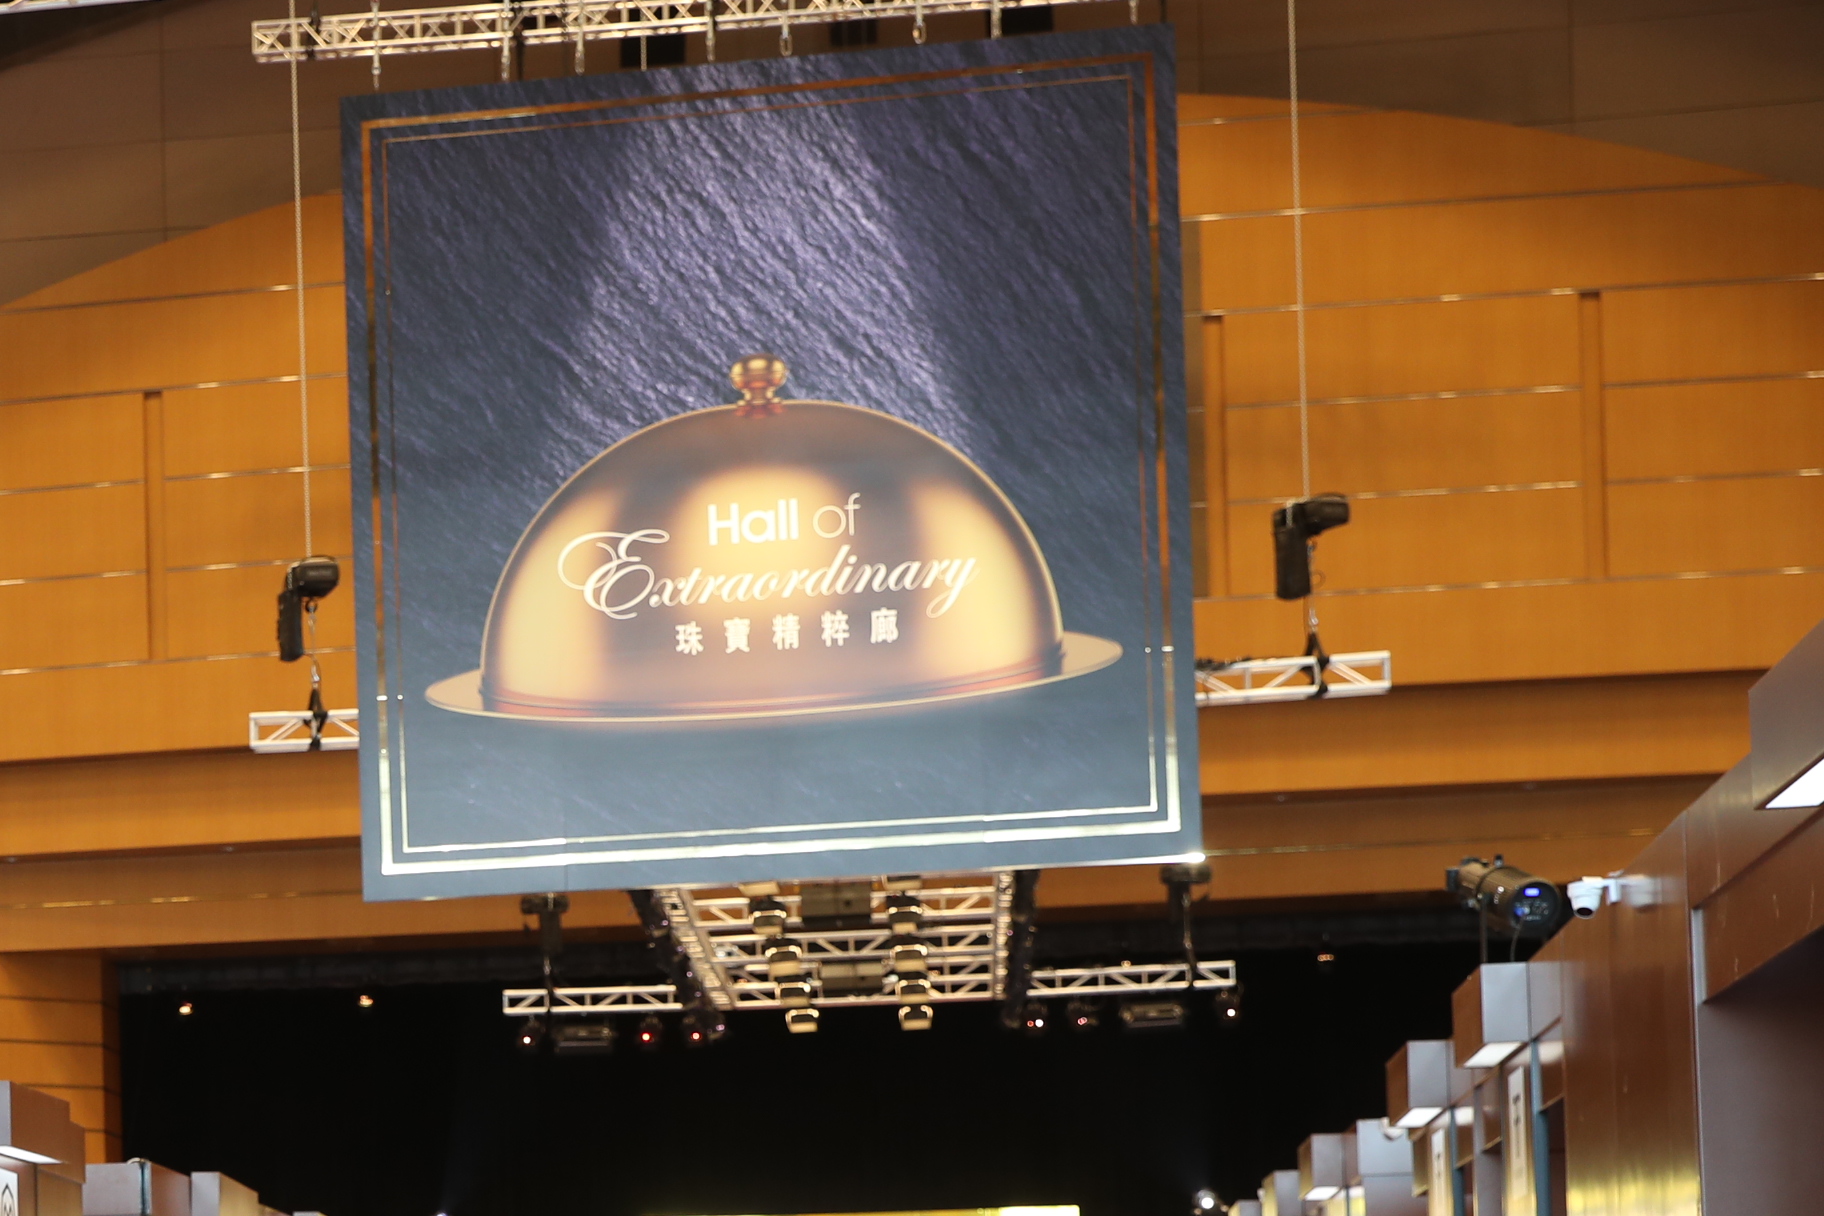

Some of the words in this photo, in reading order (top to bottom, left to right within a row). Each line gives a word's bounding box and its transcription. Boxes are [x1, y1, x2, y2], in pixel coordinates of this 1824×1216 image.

[707, 498, 799, 546] Hall
[812, 492, 861, 538] of
[557, 528, 978, 620] Extraordinary
[675, 607, 899, 656] 珠寶精粹廊
